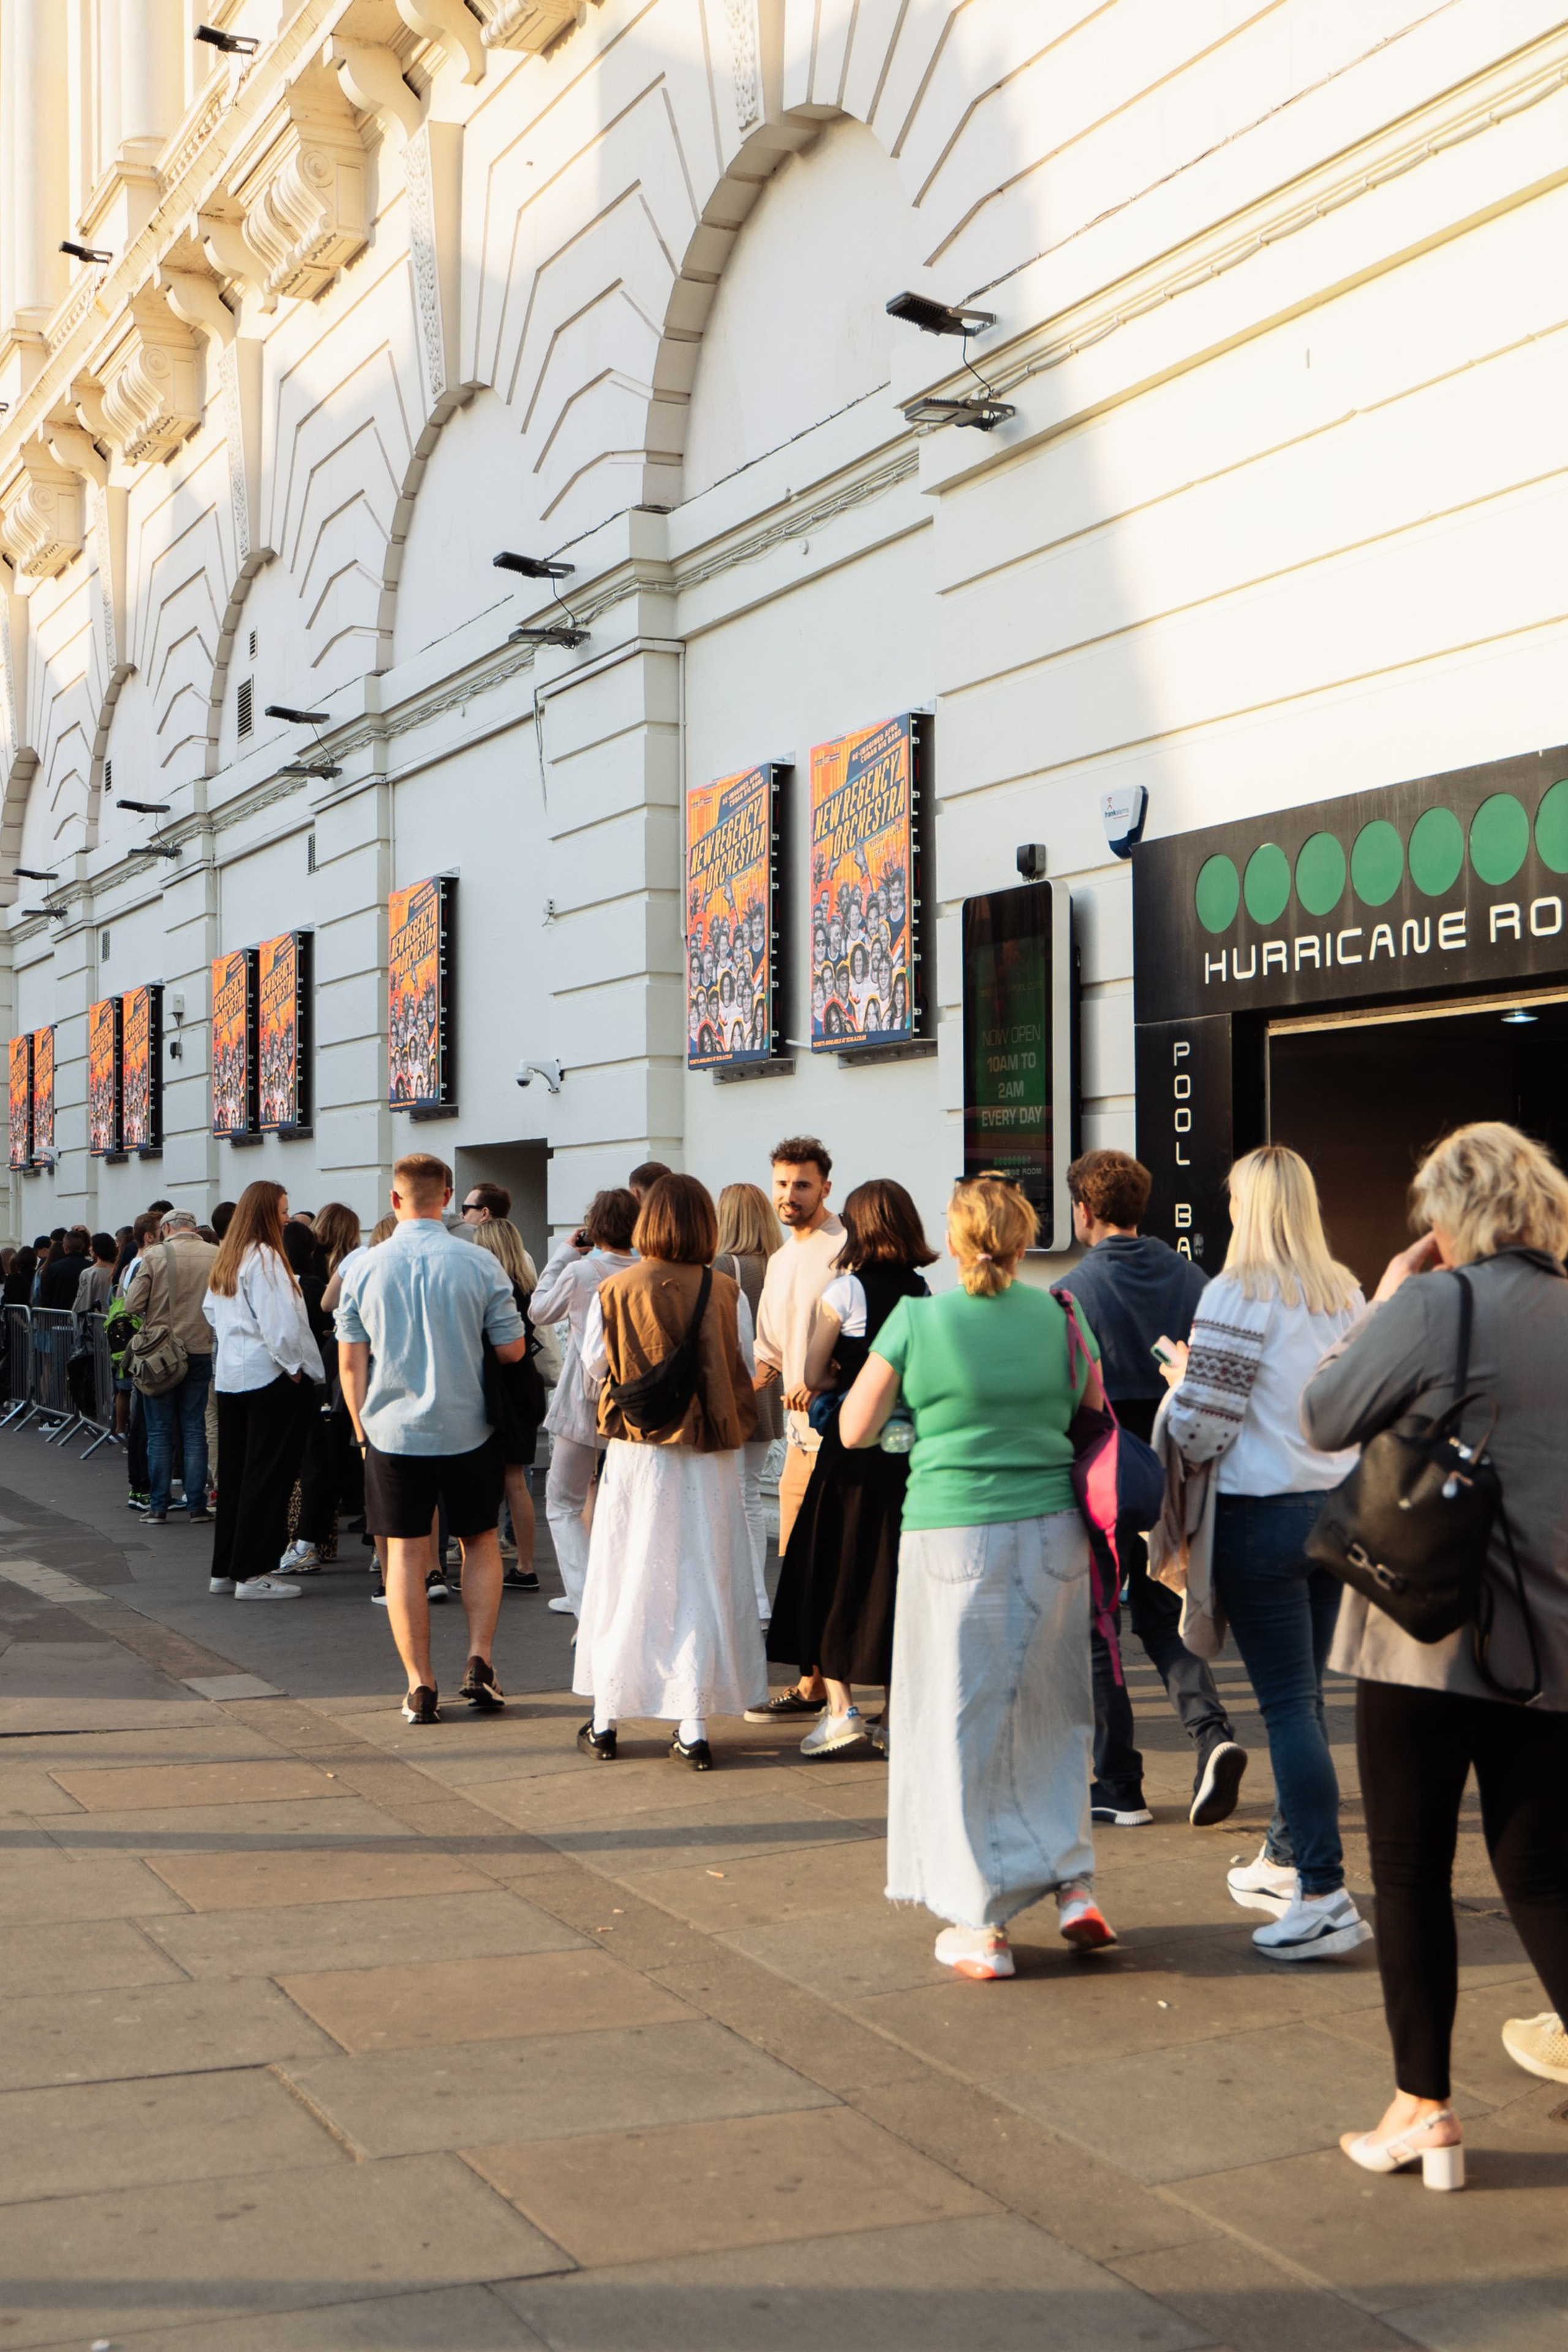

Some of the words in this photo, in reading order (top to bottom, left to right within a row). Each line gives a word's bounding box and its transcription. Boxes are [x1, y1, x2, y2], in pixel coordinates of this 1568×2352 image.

[814, 792, 843, 842] NEW
[842, 751, 899, 821] REGENCY
[833, 780, 905, 859] ORCHESTRA
[690, 833, 715, 877] NEW
[713, 797, 761, 860] REGENCY
[706, 823, 765, 894] ORCHESTRA
[1205, 910, 1466, 984] HURRICANE
[1490, 896, 1562, 943] RO
[982, 1028, 1009, 1048] NOW
[1011, 1023, 1041, 1044] OPEN
[987, 1054, 1019, 1072] 10AM
[1021, 1052, 1036, 1069] TO
[982, 1108, 1017, 1127] EVERY
[1019, 1106, 1042, 1124] DAY
[998, 1080, 1024, 1099] 2AM
[1174, 1041, 1191, 1166] POOL
